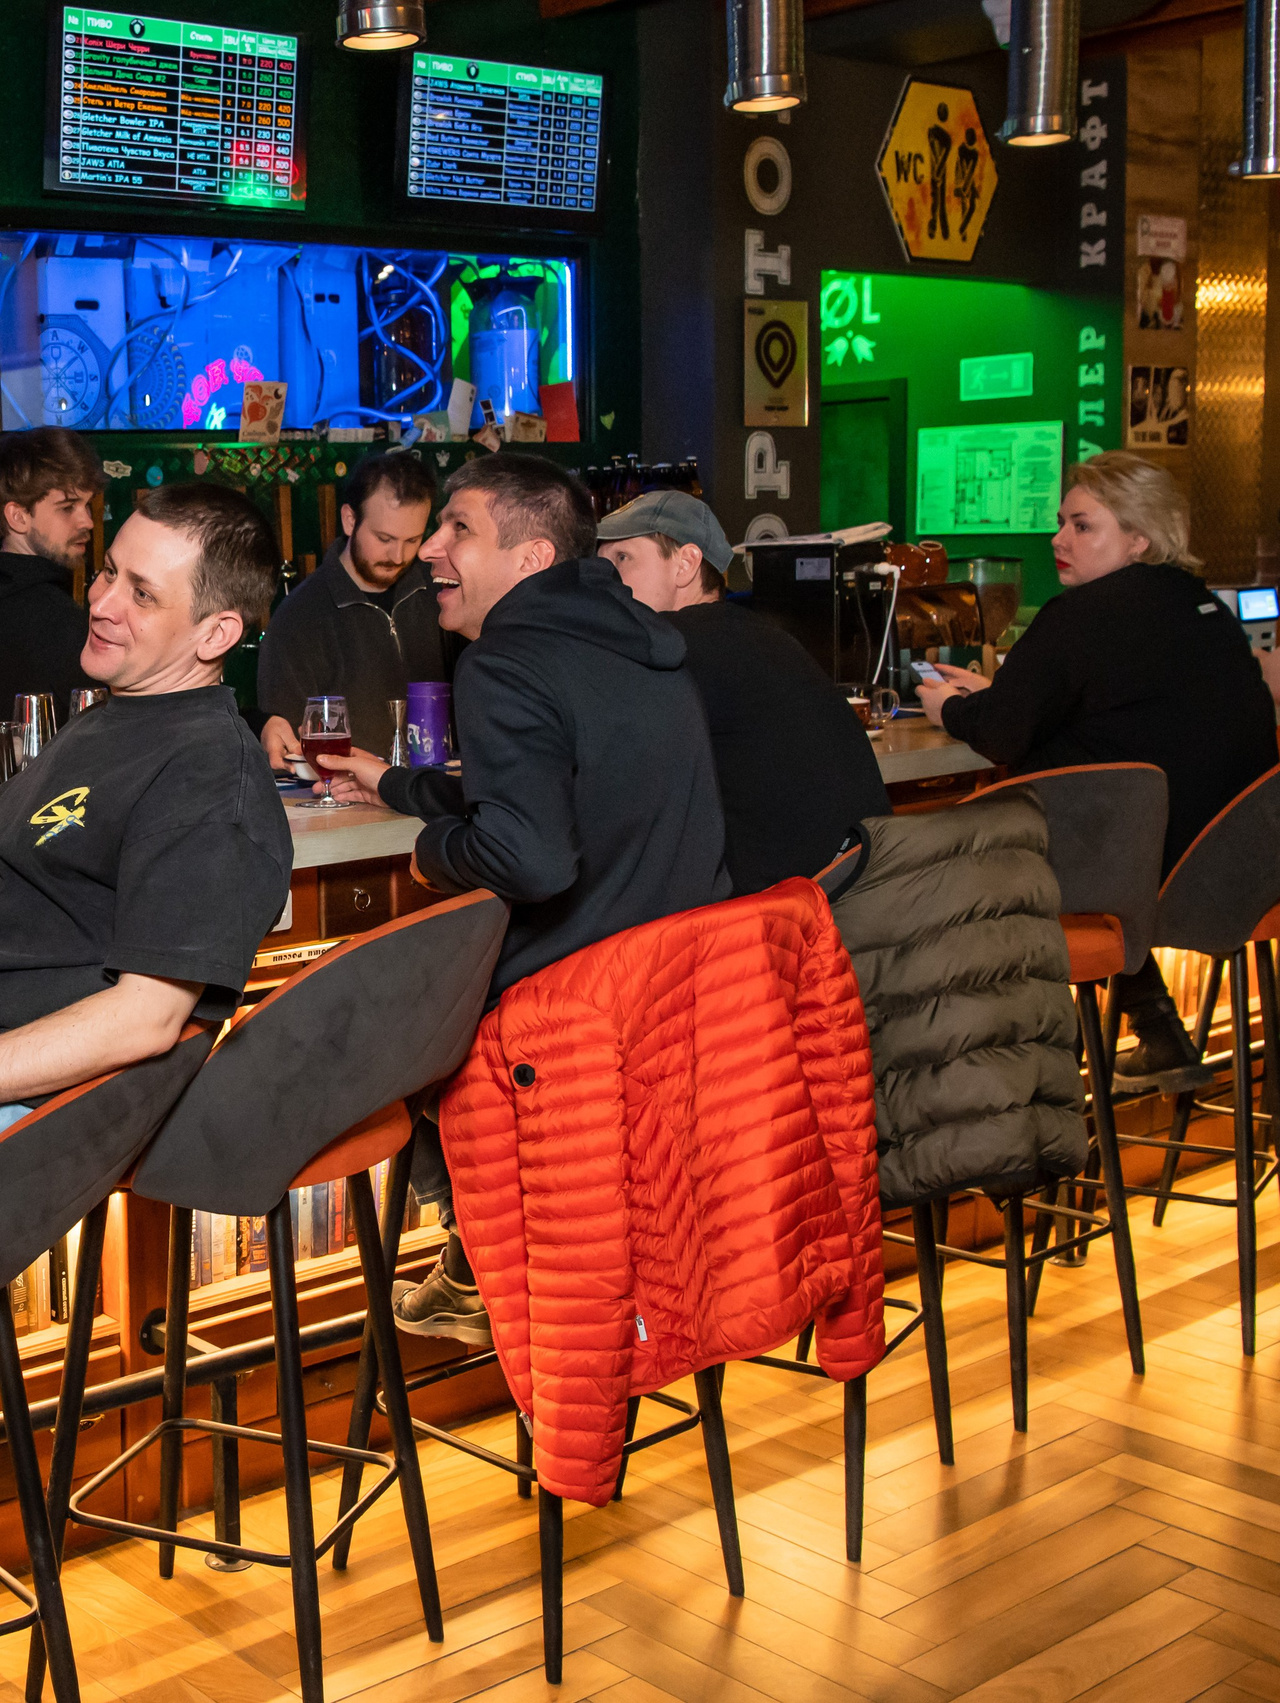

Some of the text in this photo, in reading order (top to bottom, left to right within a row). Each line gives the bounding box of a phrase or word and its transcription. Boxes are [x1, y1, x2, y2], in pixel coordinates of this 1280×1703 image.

[82, 112, 117, 124] Gletcher
[149, 119, 164, 128] IPA
[895, 150, 924, 185] WC
[1079, 79, 1109, 268] КРАФТ
